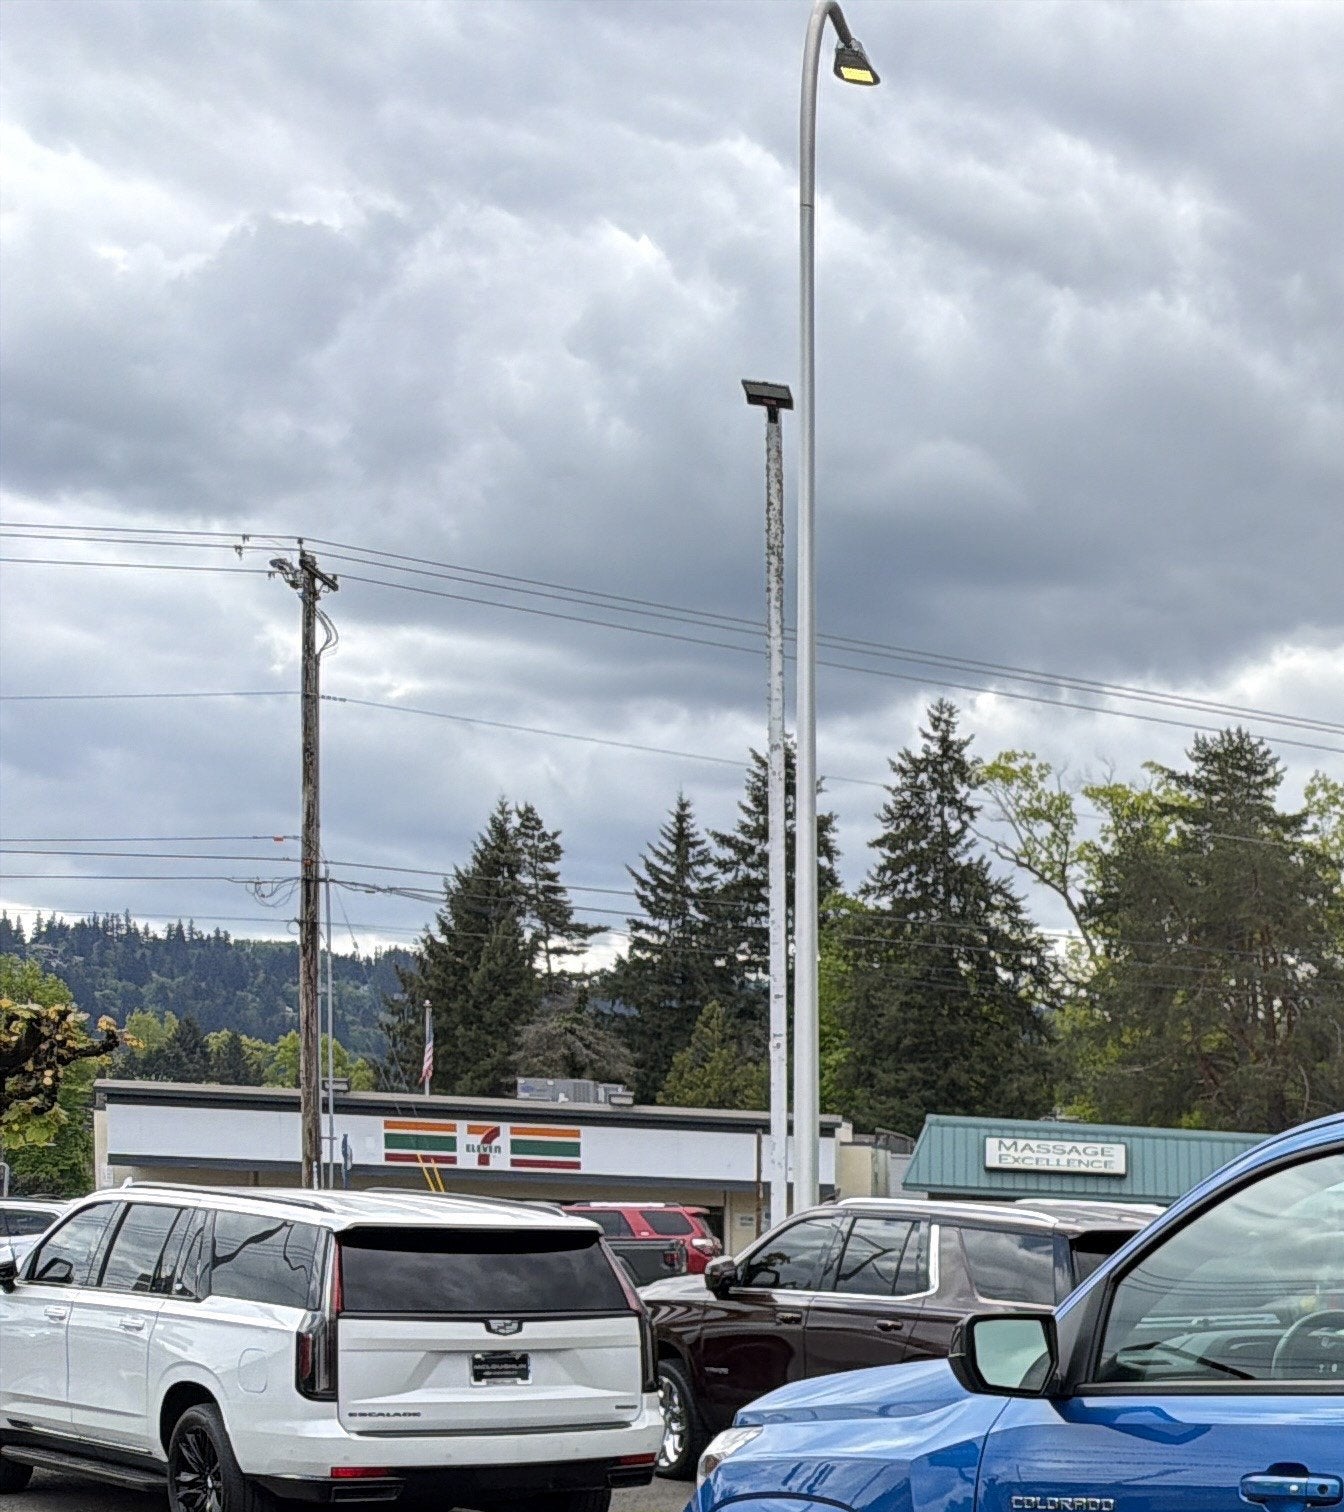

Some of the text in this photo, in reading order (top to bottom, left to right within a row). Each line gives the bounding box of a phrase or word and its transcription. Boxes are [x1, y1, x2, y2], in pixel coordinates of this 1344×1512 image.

[998, 1139, 1115, 1157] MASSAGE
[998, 1154, 1116, 1169] EXCELLENCE
[1011, 1496, 1114, 1511] COLORADO
